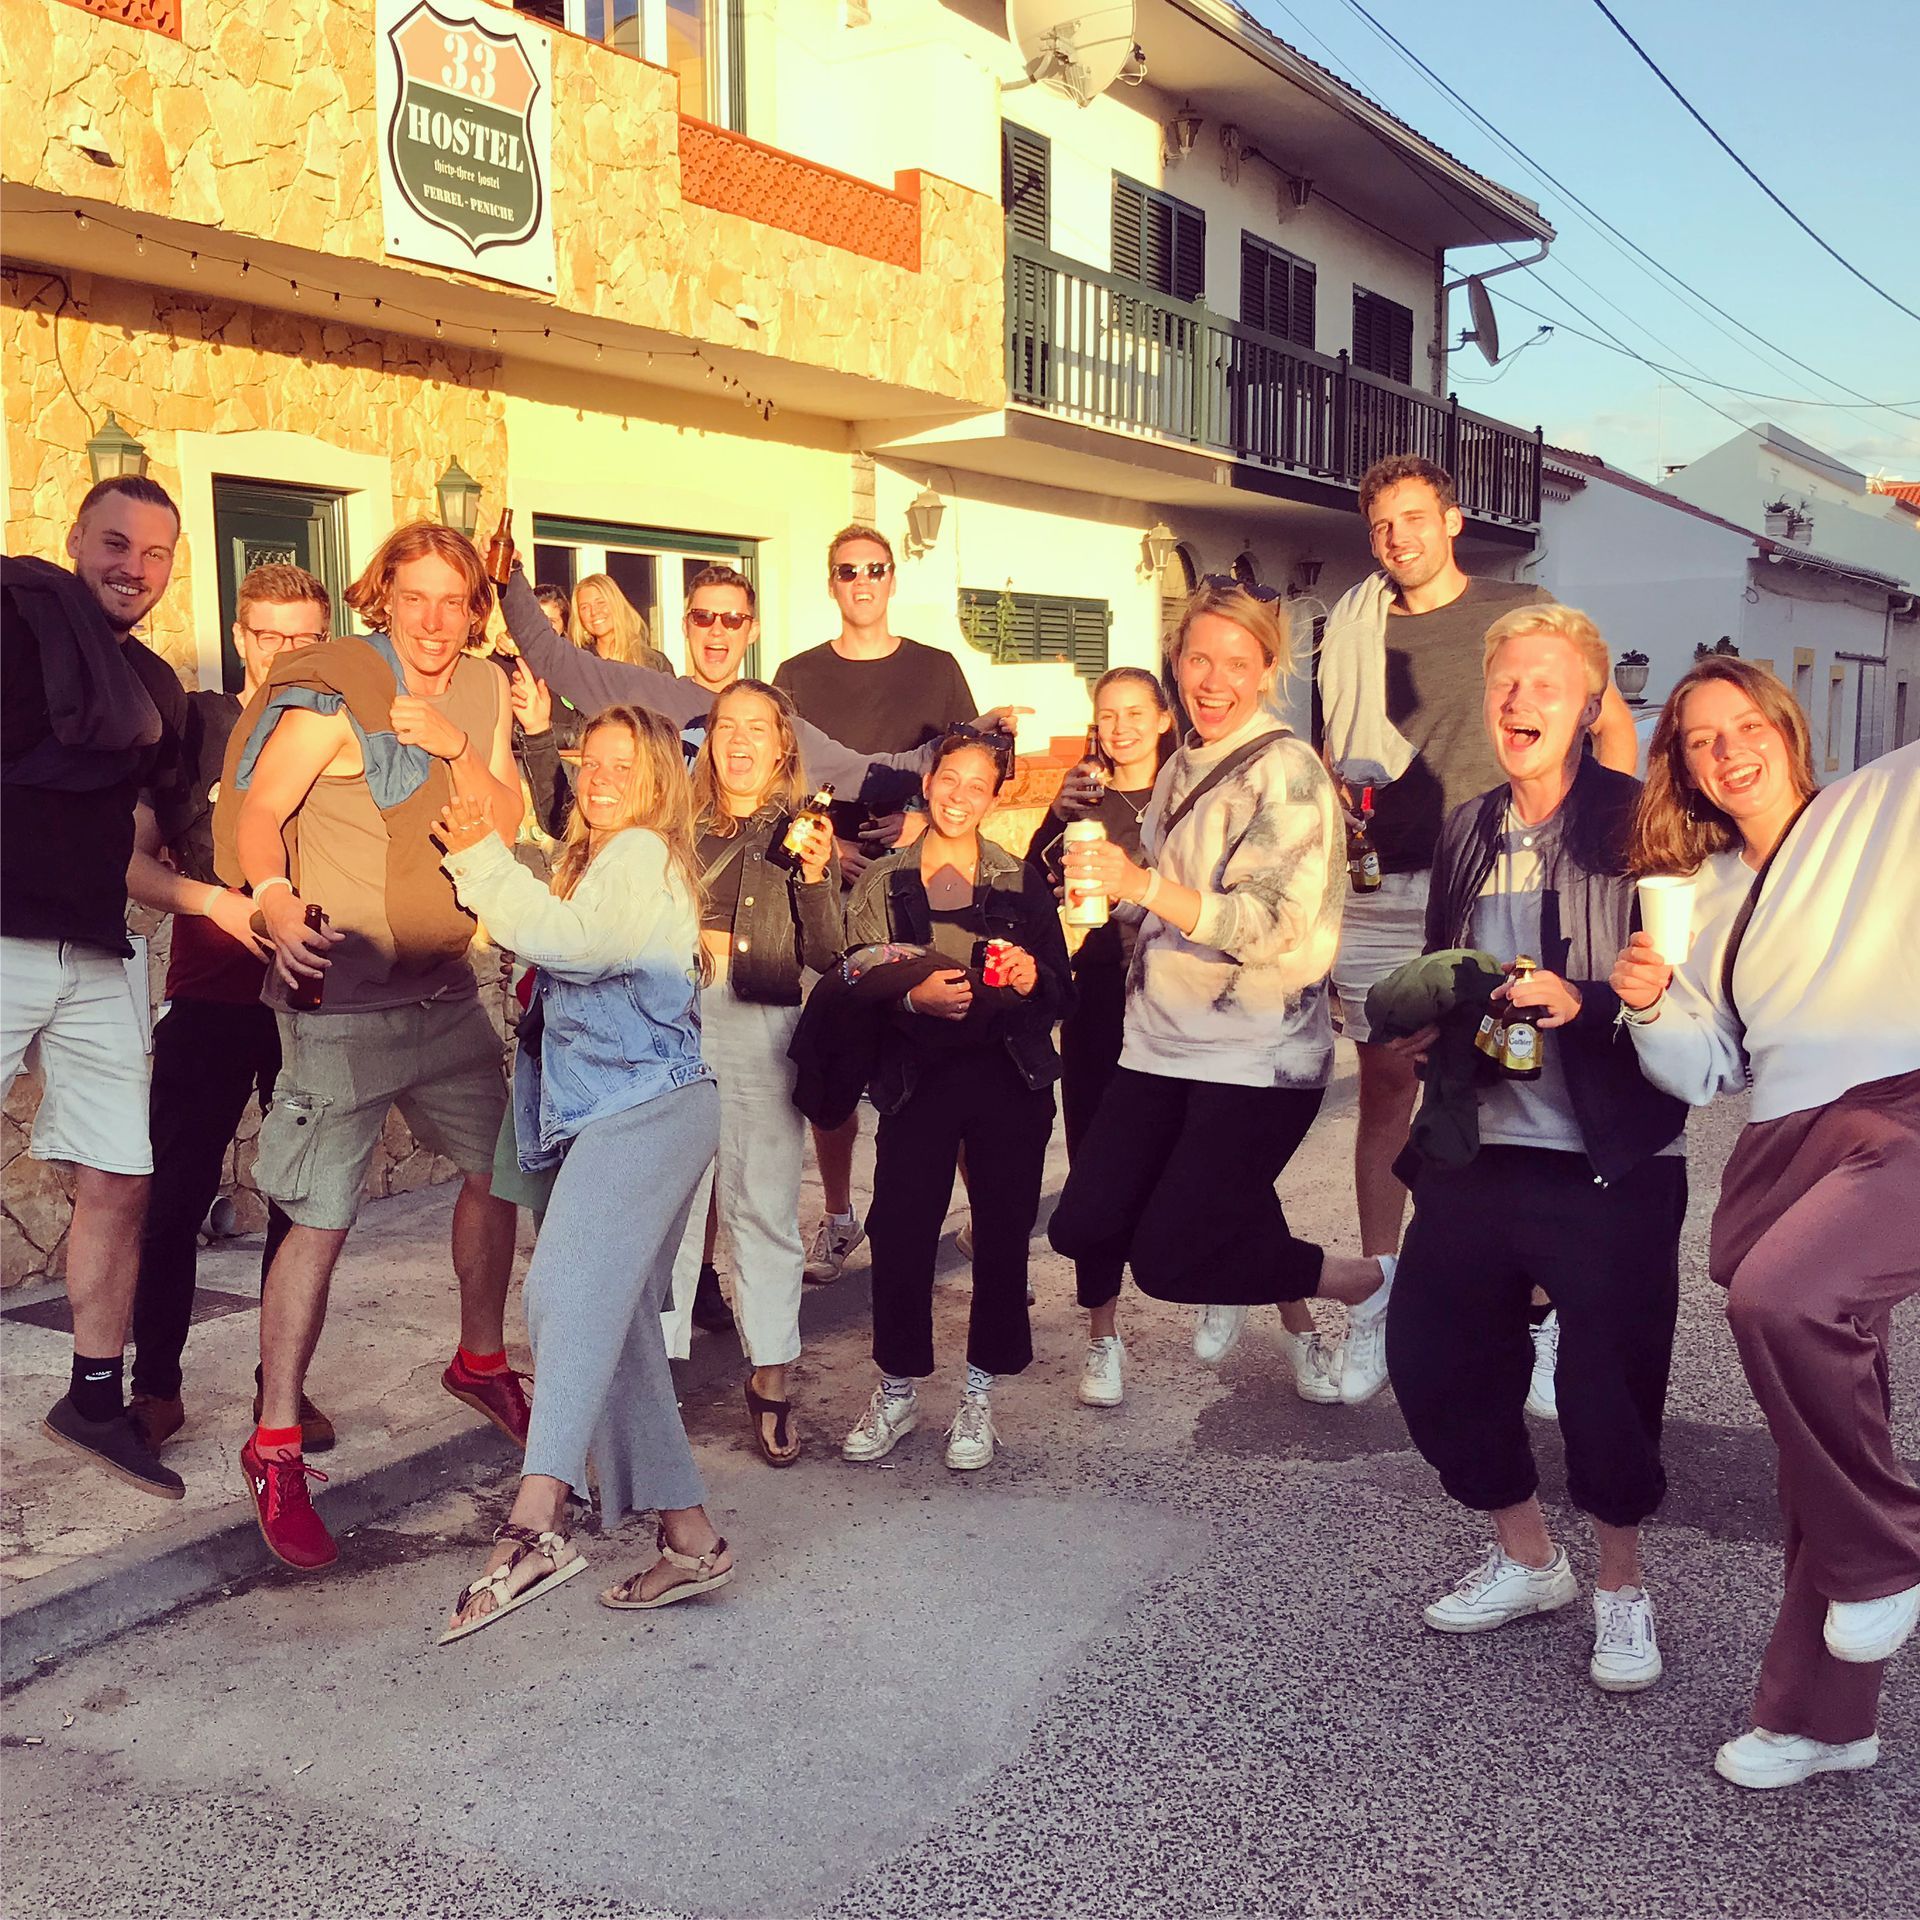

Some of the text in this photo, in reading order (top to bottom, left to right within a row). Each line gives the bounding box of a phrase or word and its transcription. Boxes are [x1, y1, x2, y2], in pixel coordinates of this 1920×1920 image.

[441, 33, 497, 100] 33
[407, 102, 524, 173] HOSTEL
[434, 158, 500, 190] thirty-three hostel
[423, 183, 465, 208] FERREL
[469, 197, 515, 222] PENICHE
